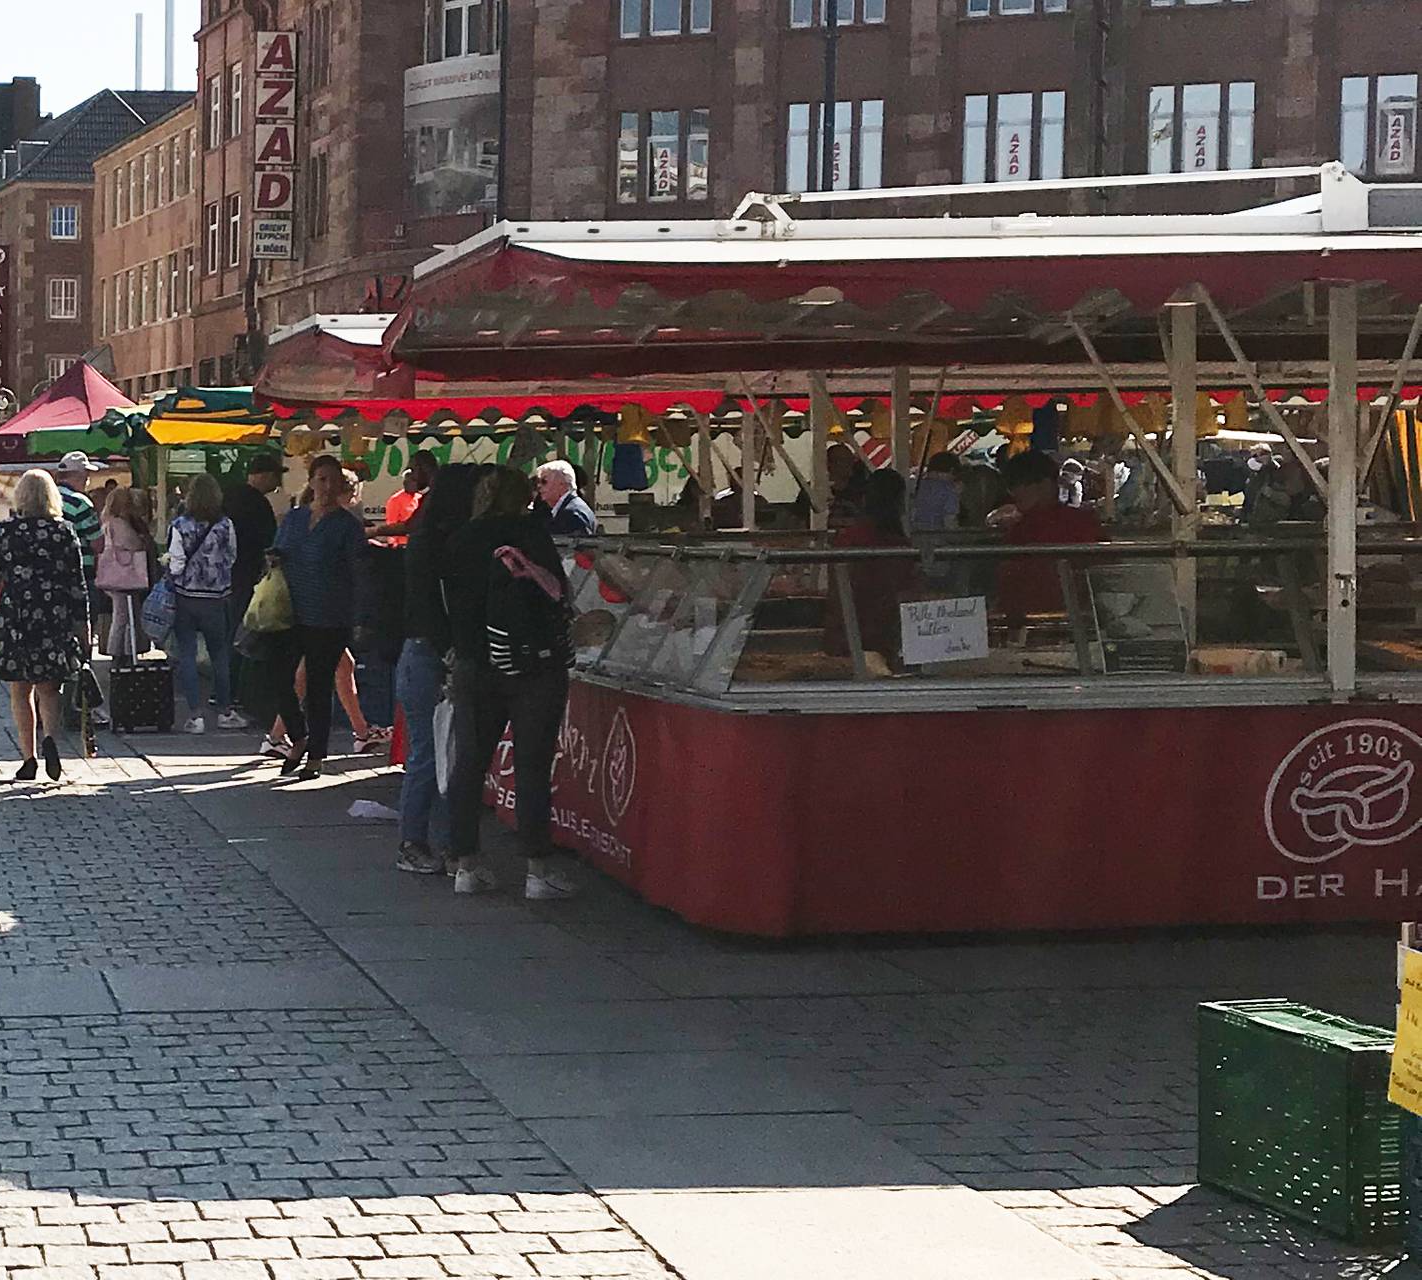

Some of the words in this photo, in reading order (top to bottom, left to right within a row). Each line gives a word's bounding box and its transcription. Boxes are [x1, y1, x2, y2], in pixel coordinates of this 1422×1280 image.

[257, 34, 294, 209] AZAD
[1391, 117, 1401, 161] AZAD
[1009, 133, 1019, 175] AZAD
[1194, 125, 1206, 168] AZAD
[659, 149, 668, 189] AZAD
[1300, 741, 1336, 786] seit
[1344, 733, 1403, 761] 1903
[1257, 873, 1345, 899] DER
[1375, 868, 1422, 897] H
